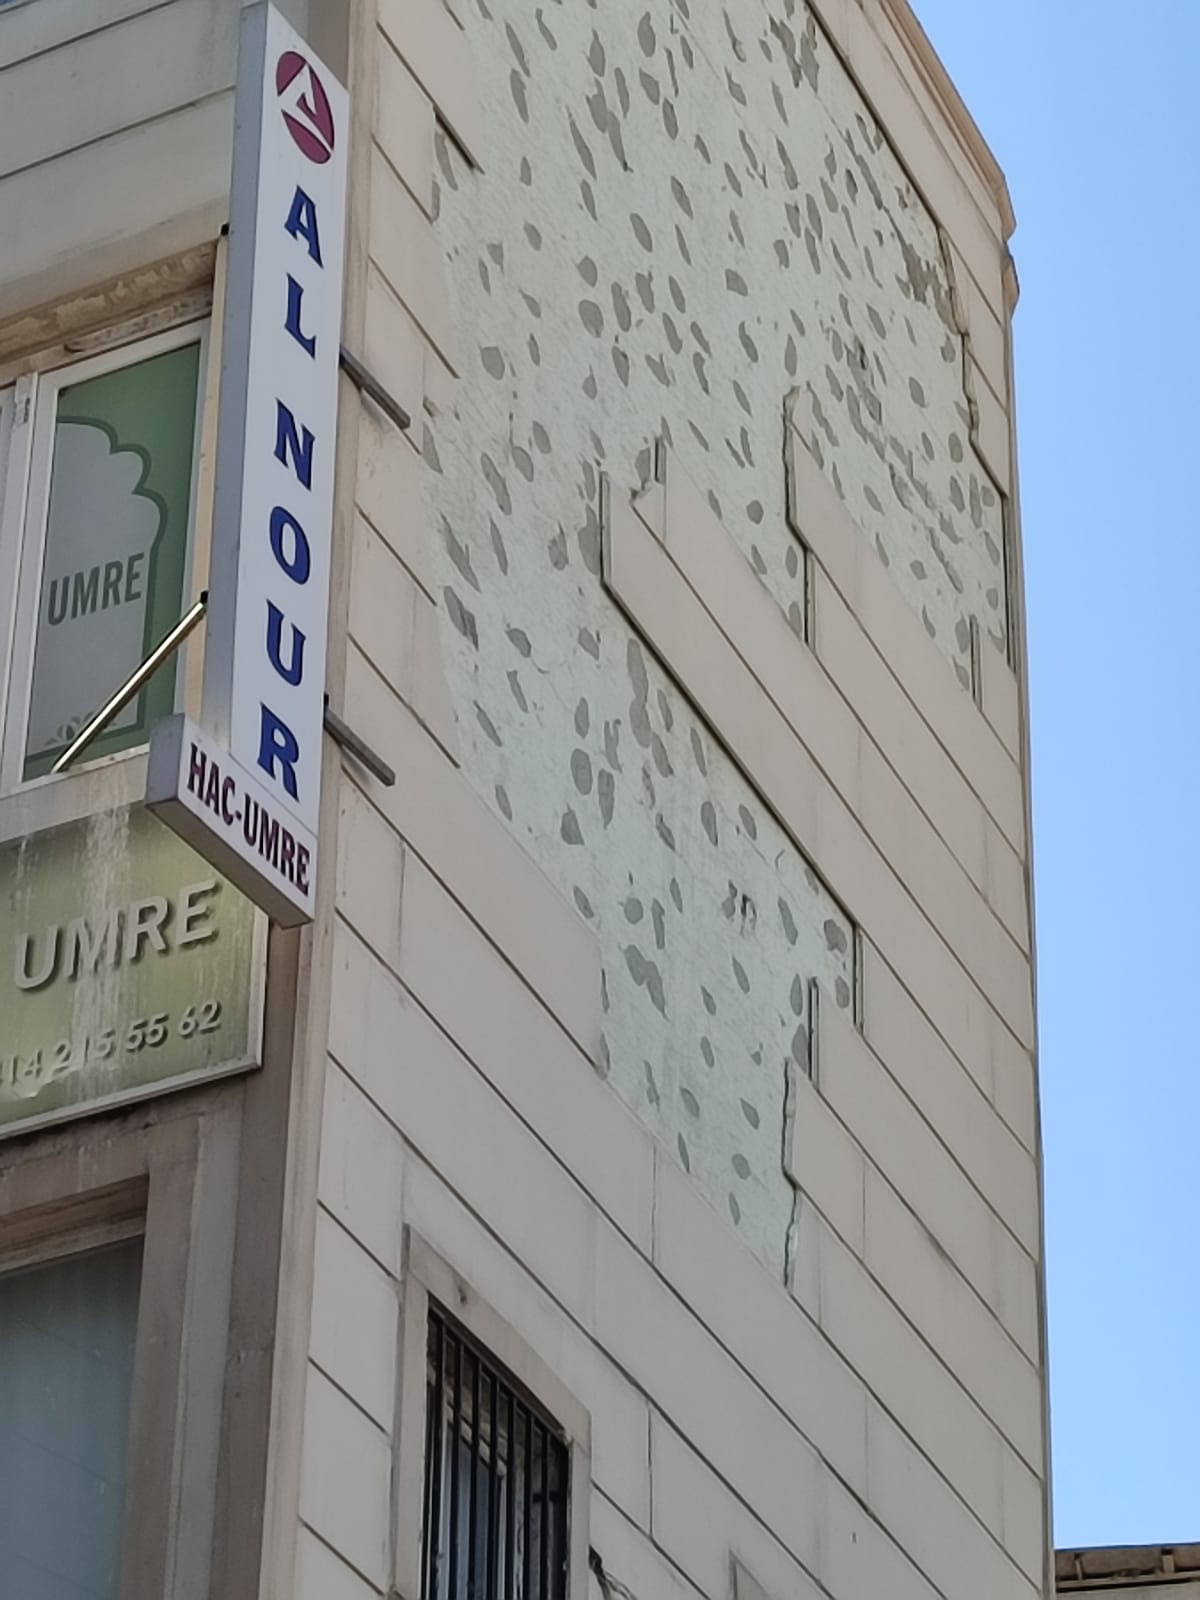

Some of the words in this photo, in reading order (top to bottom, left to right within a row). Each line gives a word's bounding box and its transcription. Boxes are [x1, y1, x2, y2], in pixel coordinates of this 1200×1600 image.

[284, 184, 325, 361] AL
[47, 552, 146, 626] UMRE
[257, 398, 316, 802] NOUR
[187, 741, 311, 897] HAC-UMRE
[14, 879, 221, 991] UMRE
[52, 1027, 117, 1077] 215
[126, 1013, 170, 1053] 55
[177, 1000, 222, 1039] 62
